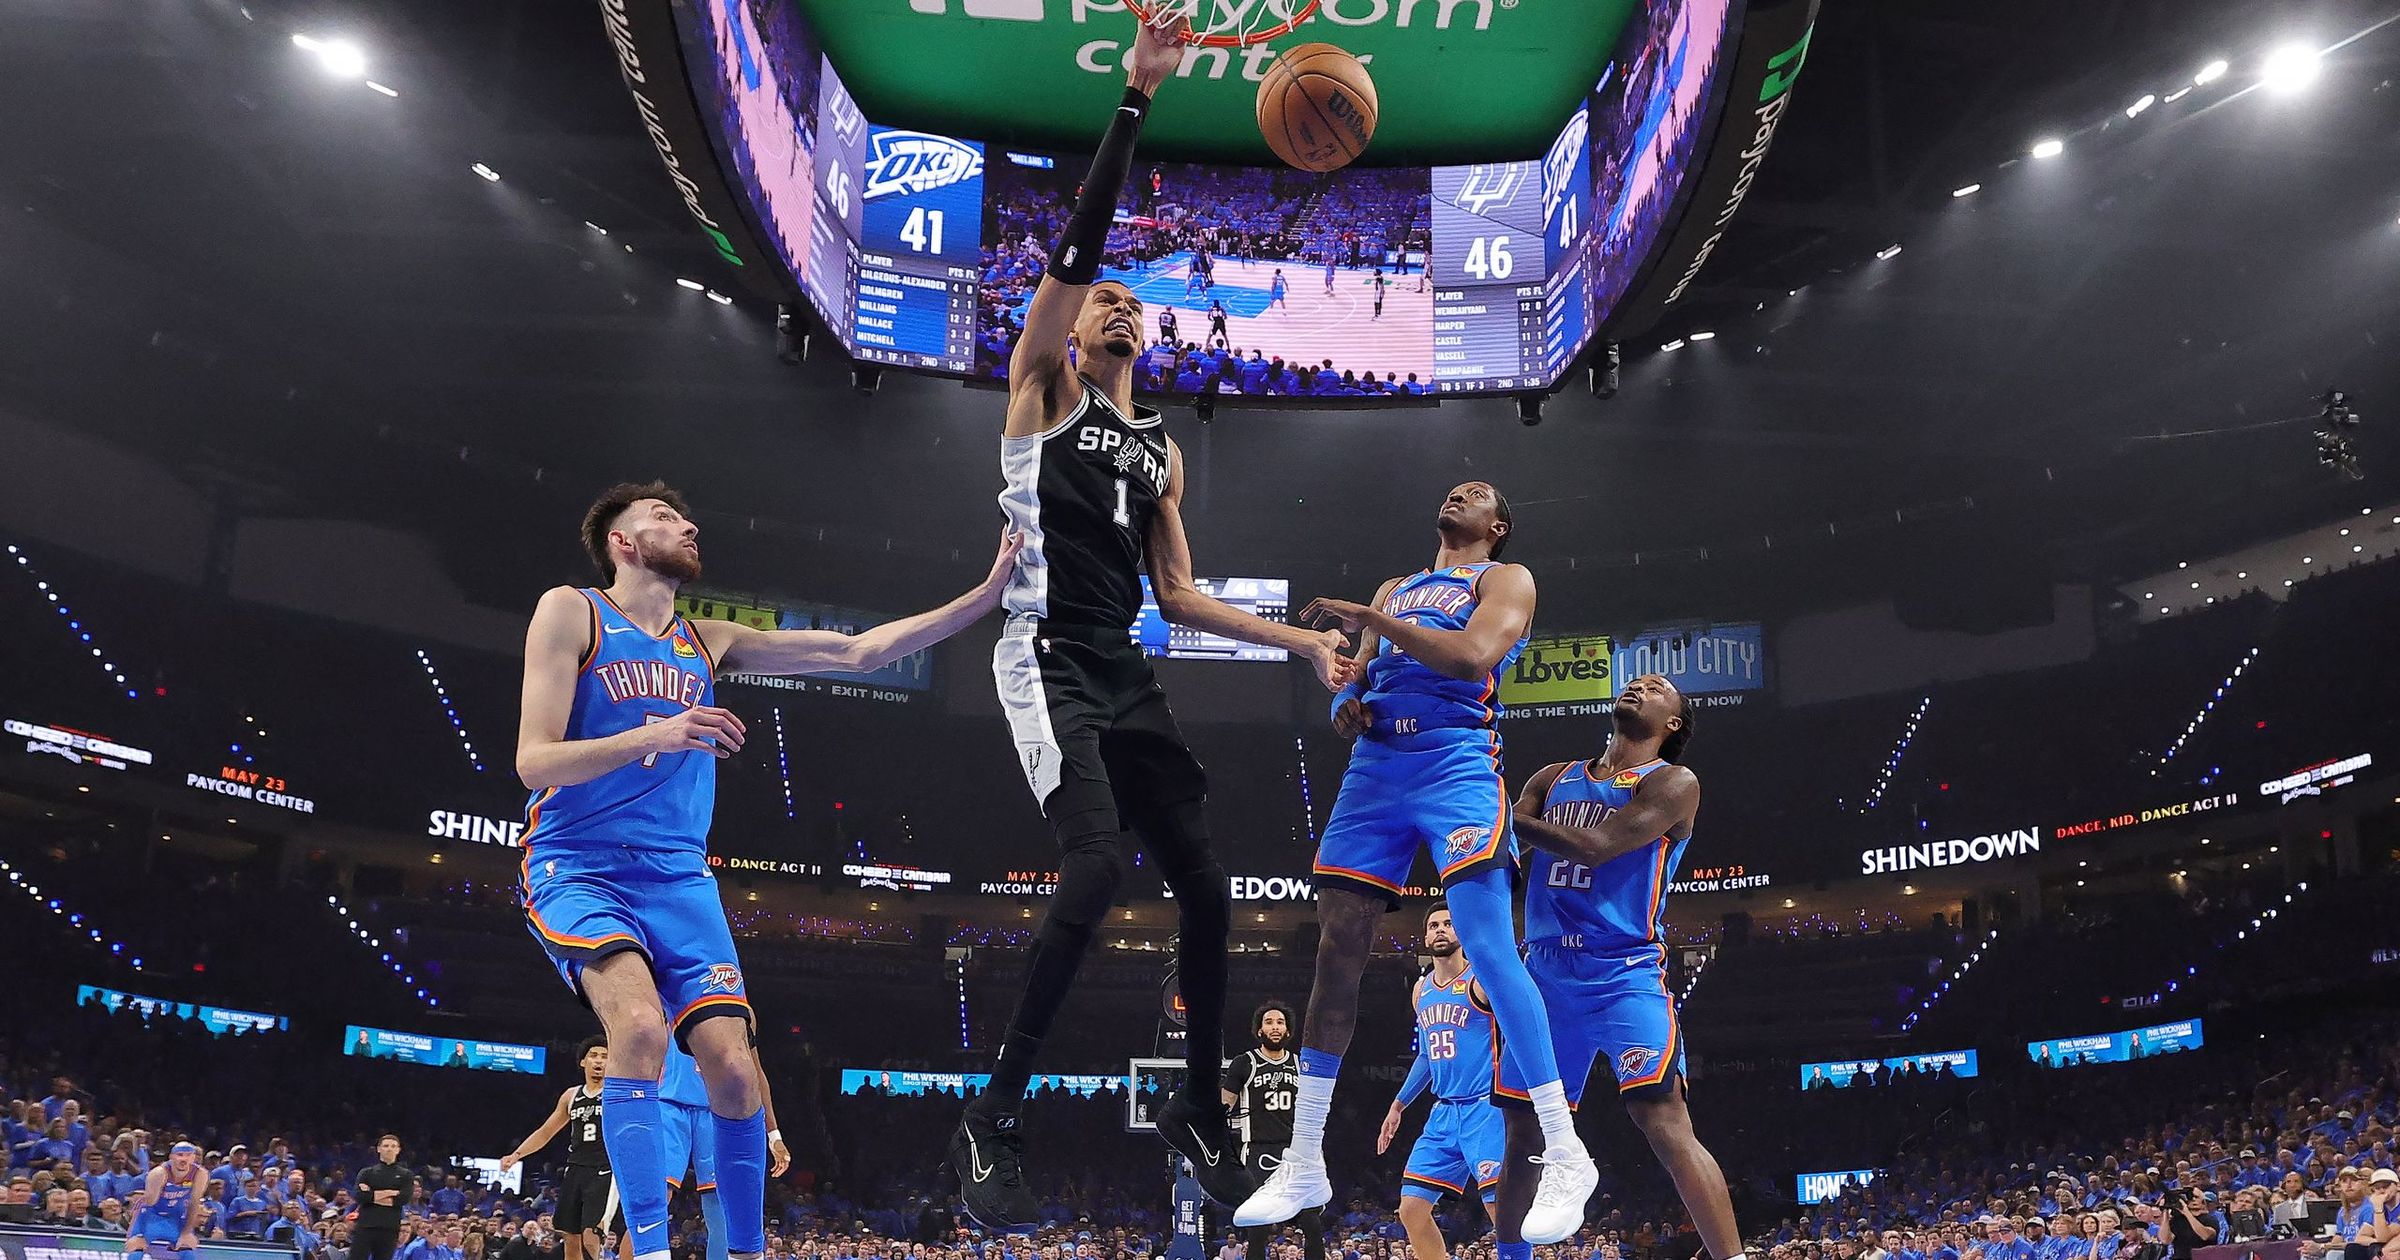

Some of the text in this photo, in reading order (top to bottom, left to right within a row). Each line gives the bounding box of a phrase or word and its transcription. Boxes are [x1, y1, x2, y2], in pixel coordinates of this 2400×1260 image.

[602, 0, 720, 229] paycom cent
[1714, 93, 1788, 227] paycom
[827, 158, 850, 219] 46
[900, 206, 945, 256] 41
[1560, 193, 1578, 249] 41
[863, 253, 976, 280] PLAYER PTS FL
[1464, 236, 1513, 280] 46
[860, 269, 973, 294] GILGEOUS-ALEXANDER 4 0
[1436, 286, 1543, 300] PLAYER PTS FL
[859, 284, 972, 310] HOLMGREN 2 1
[1434, 302, 1541, 316] WEMBANYAMA 12 0
[858, 300, 972, 325] WILLIAMS 12 2
[1435, 316, 1542, 331] HARPER 7 1
[857, 315, 971, 340] WALLACE 3 0
[1436, 332, 1542, 346] CASTLE 11 1
[856, 331, 970, 356] MITCHELL 0 2
[1436, 346, 1542, 361] VASSELL 2 0
[861, 348, 966, 371] TO 5 TF 1 2ND 1:35
[1436, 362, 1543, 376] CHAMPAGNIE 3 1
[1441, 378, 1540, 392] TO 5 TF 3 2ND 1:35
[1112, 478, 1130, 528] 1
[1618, 637, 1755, 690] LOUD CITY
[728, 673, 910, 704] THUNDER EXIT NOW
[1535, 706, 1566, 717] THE
[1570, 702, 1613, 716] THUN
[1705, 694, 1743, 707] NOW
[1396, 718, 1418, 734] OKC
[222, 766, 286, 791] MAY 23
[186, 773, 314, 814] PAYCOM CENTER
[2056, 793, 2238, 838] DANCE, KID, DANCE ACT II
[428, 810, 525, 848] SHINE
[1862, 826, 2040, 876] SHINEDOWN
[708, 856, 821, 875] ID, DANCE ACT II
[1008, 871, 1059, 882] MAY 23
[1694, 866, 1744, 879] MAY 23
[980, 882, 1032, 894] PAYCOM
[1667, 874, 1770, 893] PAYCOM CENTER
[1420, 1004, 1470, 1031] THUNDER
[1429, 1030, 1455, 1060] 25
[902, 1072, 963, 1082] PHIL WICKHAM
[1078, 1076, 1121, 1084] WICKAM
[1264, 1090, 1292, 1111] 30
[570, 1104, 602, 1122] SPUR
[582, 1123, 597, 1142] 2
[1180, 1211, 1194, 1222] THE
[1181, 1200, 1194, 1211] GET
